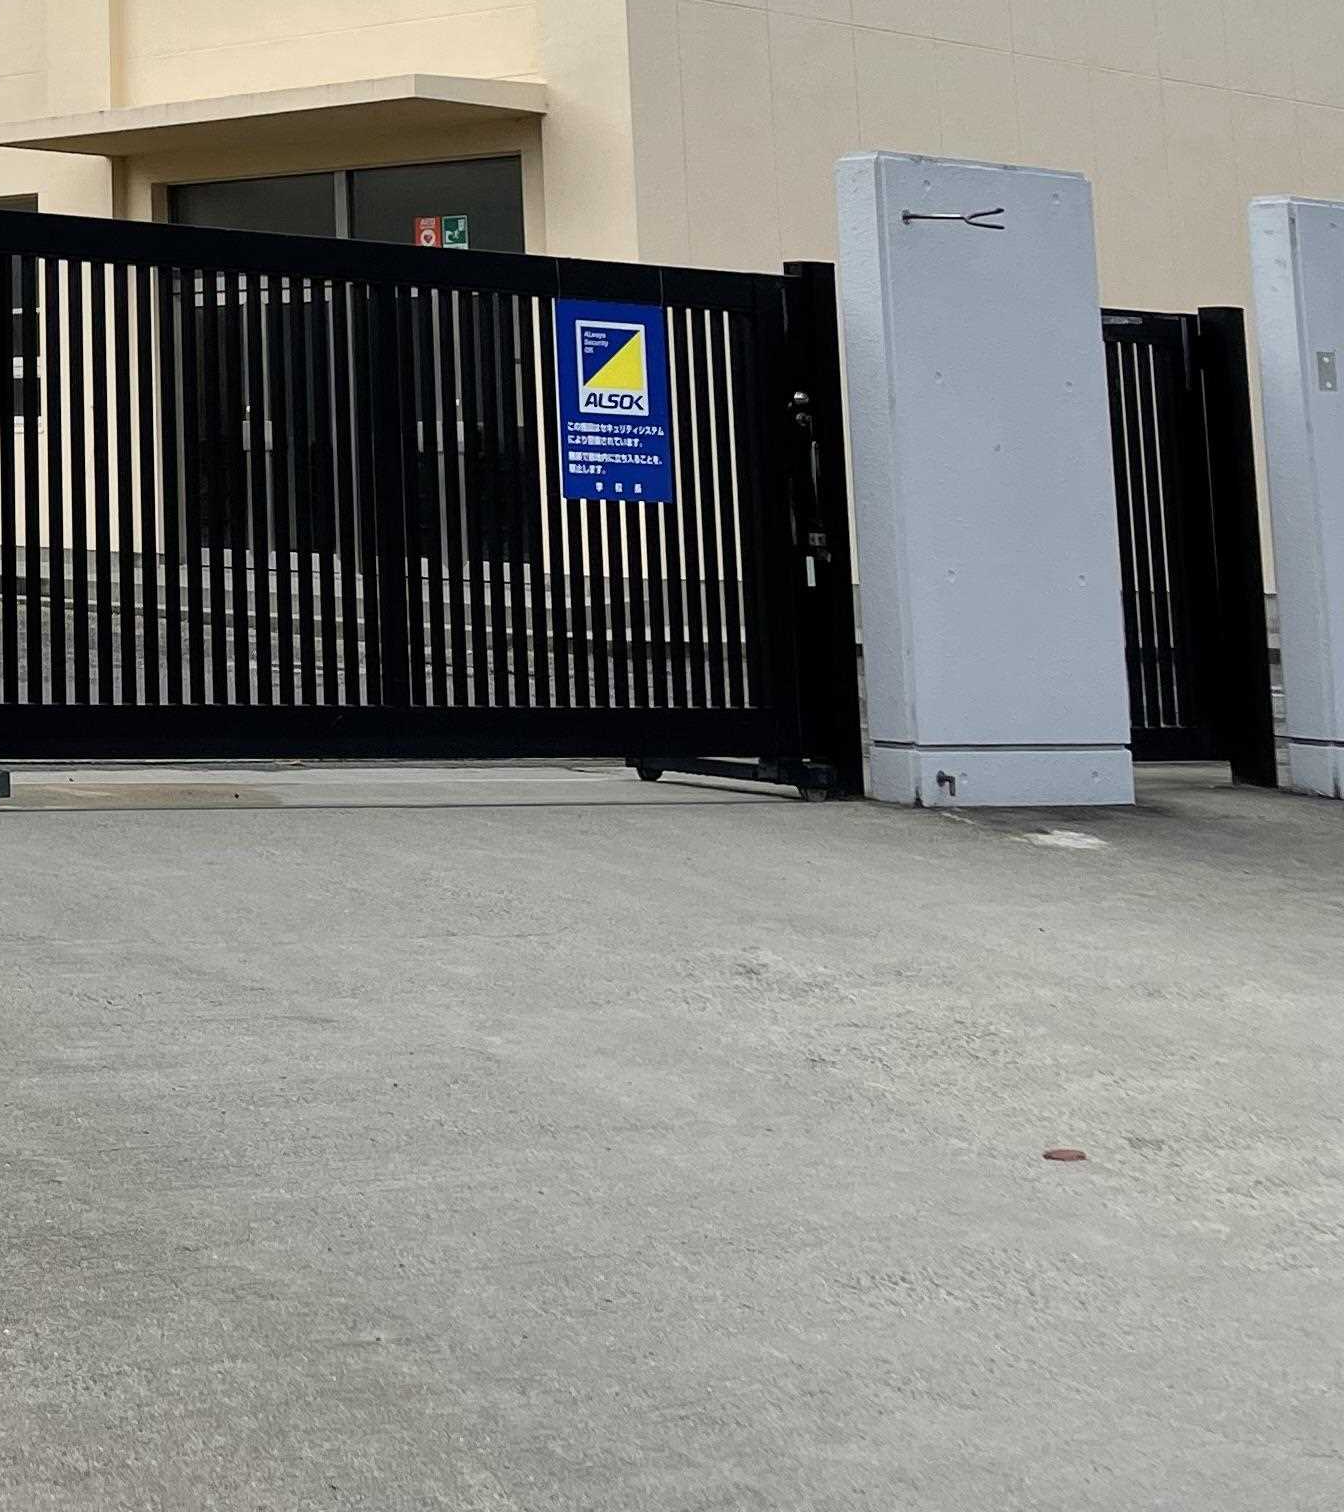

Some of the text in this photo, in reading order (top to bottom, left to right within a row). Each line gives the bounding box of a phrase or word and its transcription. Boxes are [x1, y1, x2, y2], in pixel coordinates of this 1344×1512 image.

[584, 392, 644, 411] ALSOK
[567, 421, 664, 436] このはセキュリティシステム
[568, 463, 607, 475] 止します。
